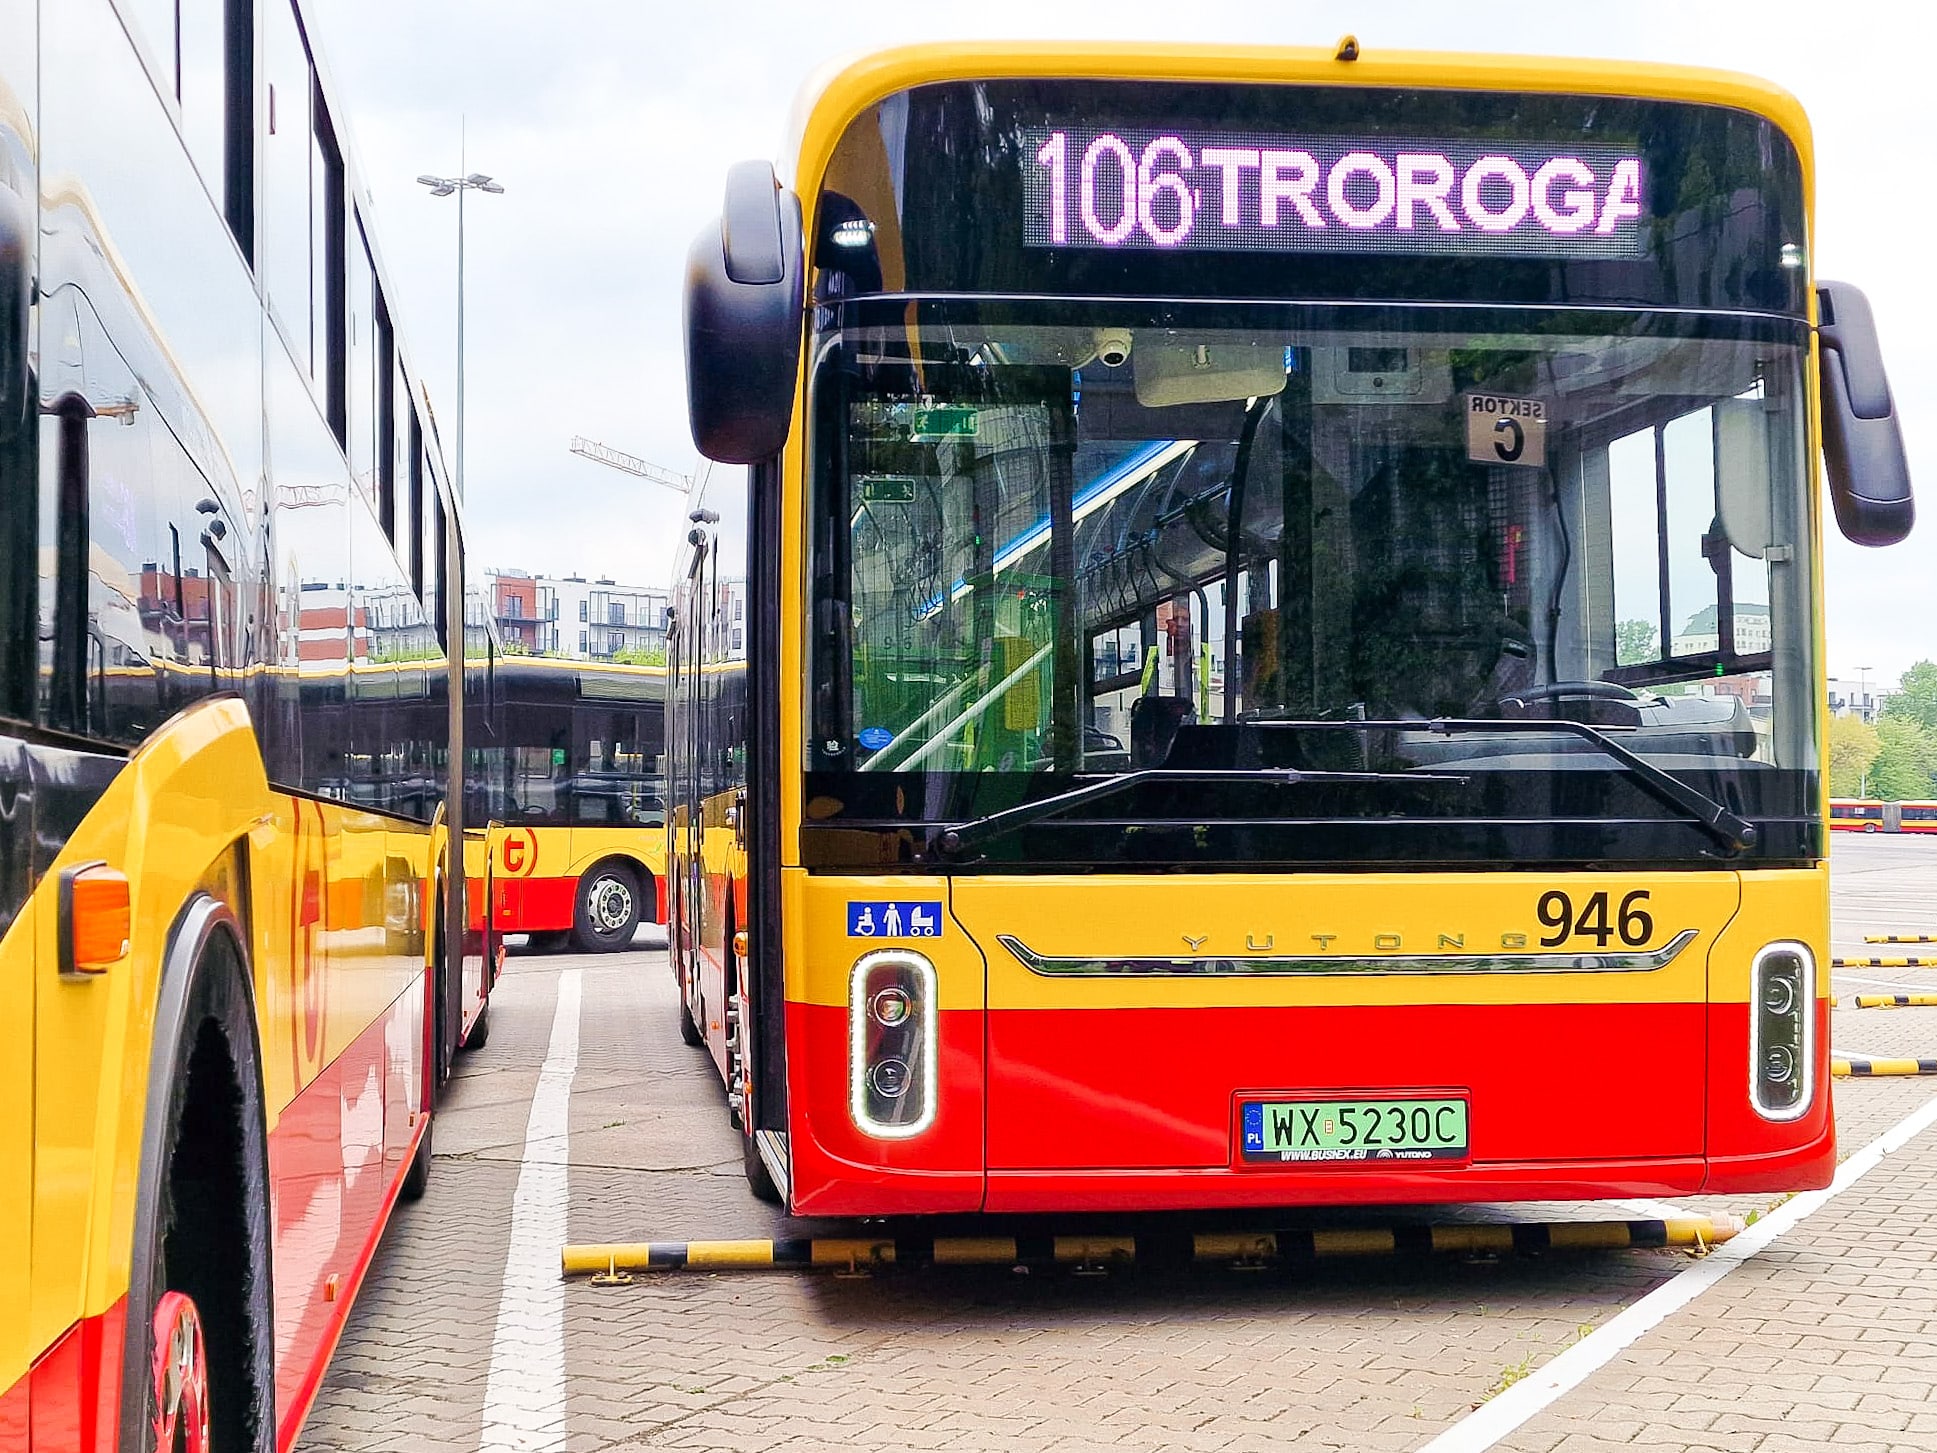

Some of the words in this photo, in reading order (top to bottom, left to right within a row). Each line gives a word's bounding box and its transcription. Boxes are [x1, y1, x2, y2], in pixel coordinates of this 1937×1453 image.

[1037, 131, 1193, 246] 106
[1194, 147, 1642, 235] TROROGA
[1537, 890, 1653, 946] 946
[1182, 933, 1527, 951] YUTONG
[1247, 1133, 1261, 1143] PL
[1272, 1108, 1320, 1146] WX
[1338, 1106, 1456, 1145] 5230C
